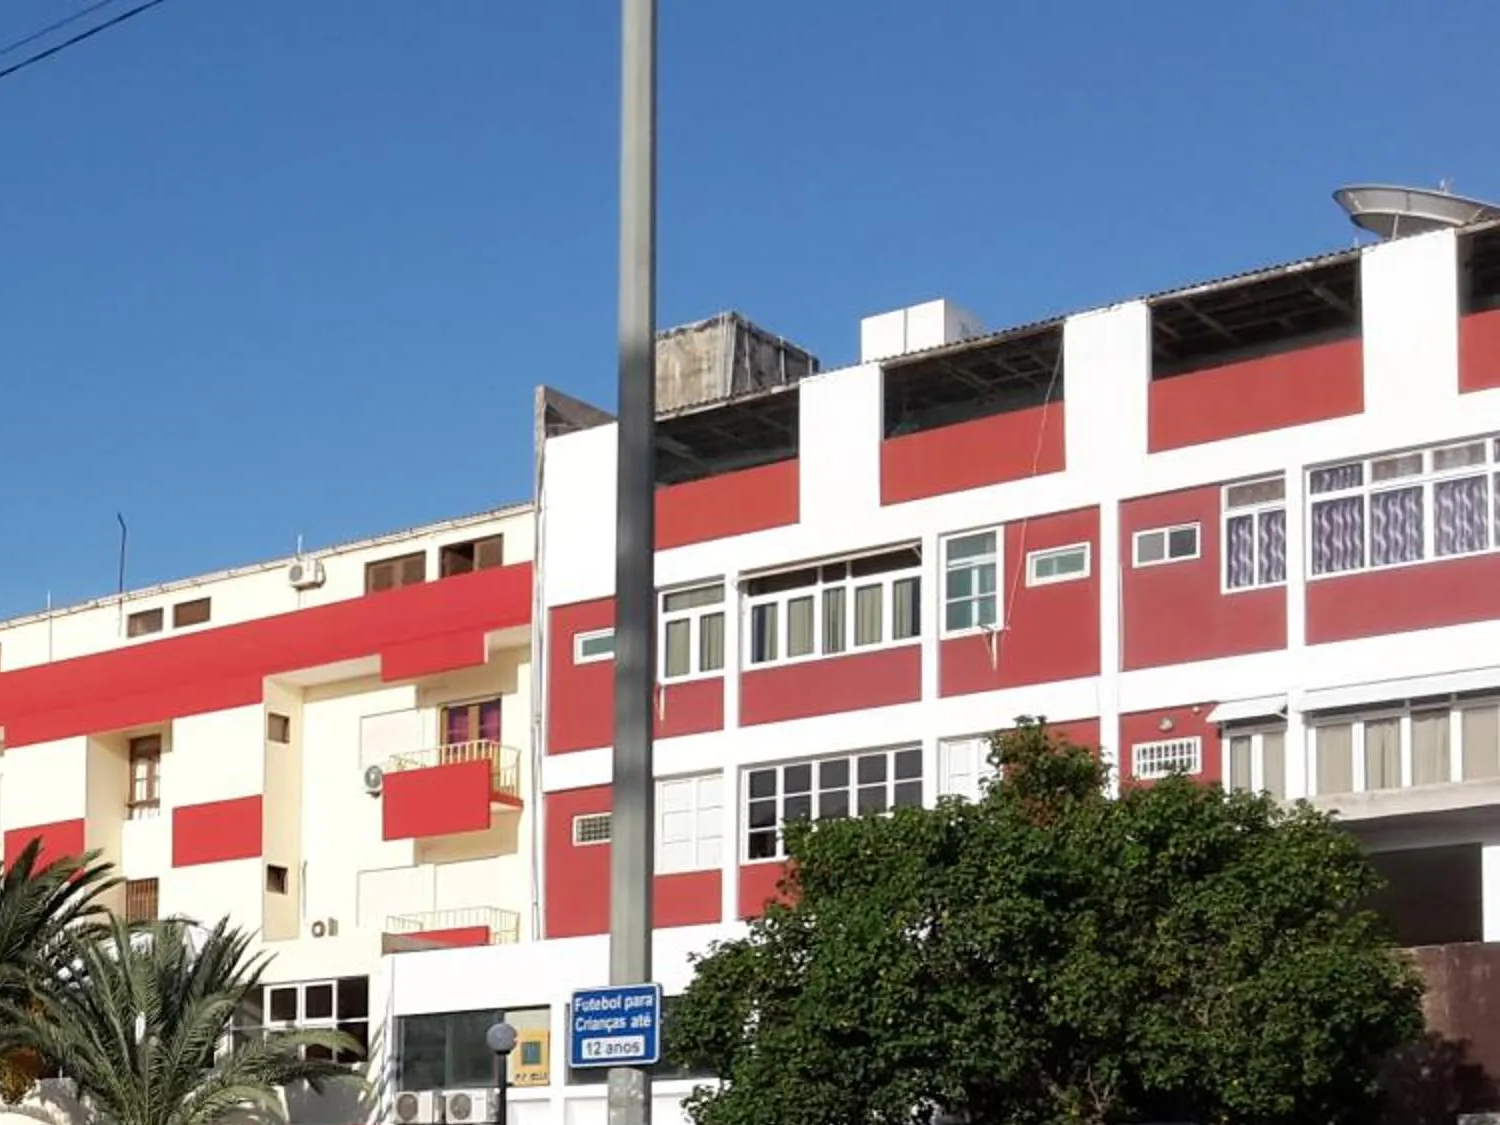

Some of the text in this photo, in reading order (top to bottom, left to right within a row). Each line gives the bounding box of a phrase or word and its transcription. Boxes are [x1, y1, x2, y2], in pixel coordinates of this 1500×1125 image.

[575, 995, 653, 1012] Futebol para
[575, 1012, 652, 1033] Crianças até
[587, 1041, 640, 1055] 12 anos
